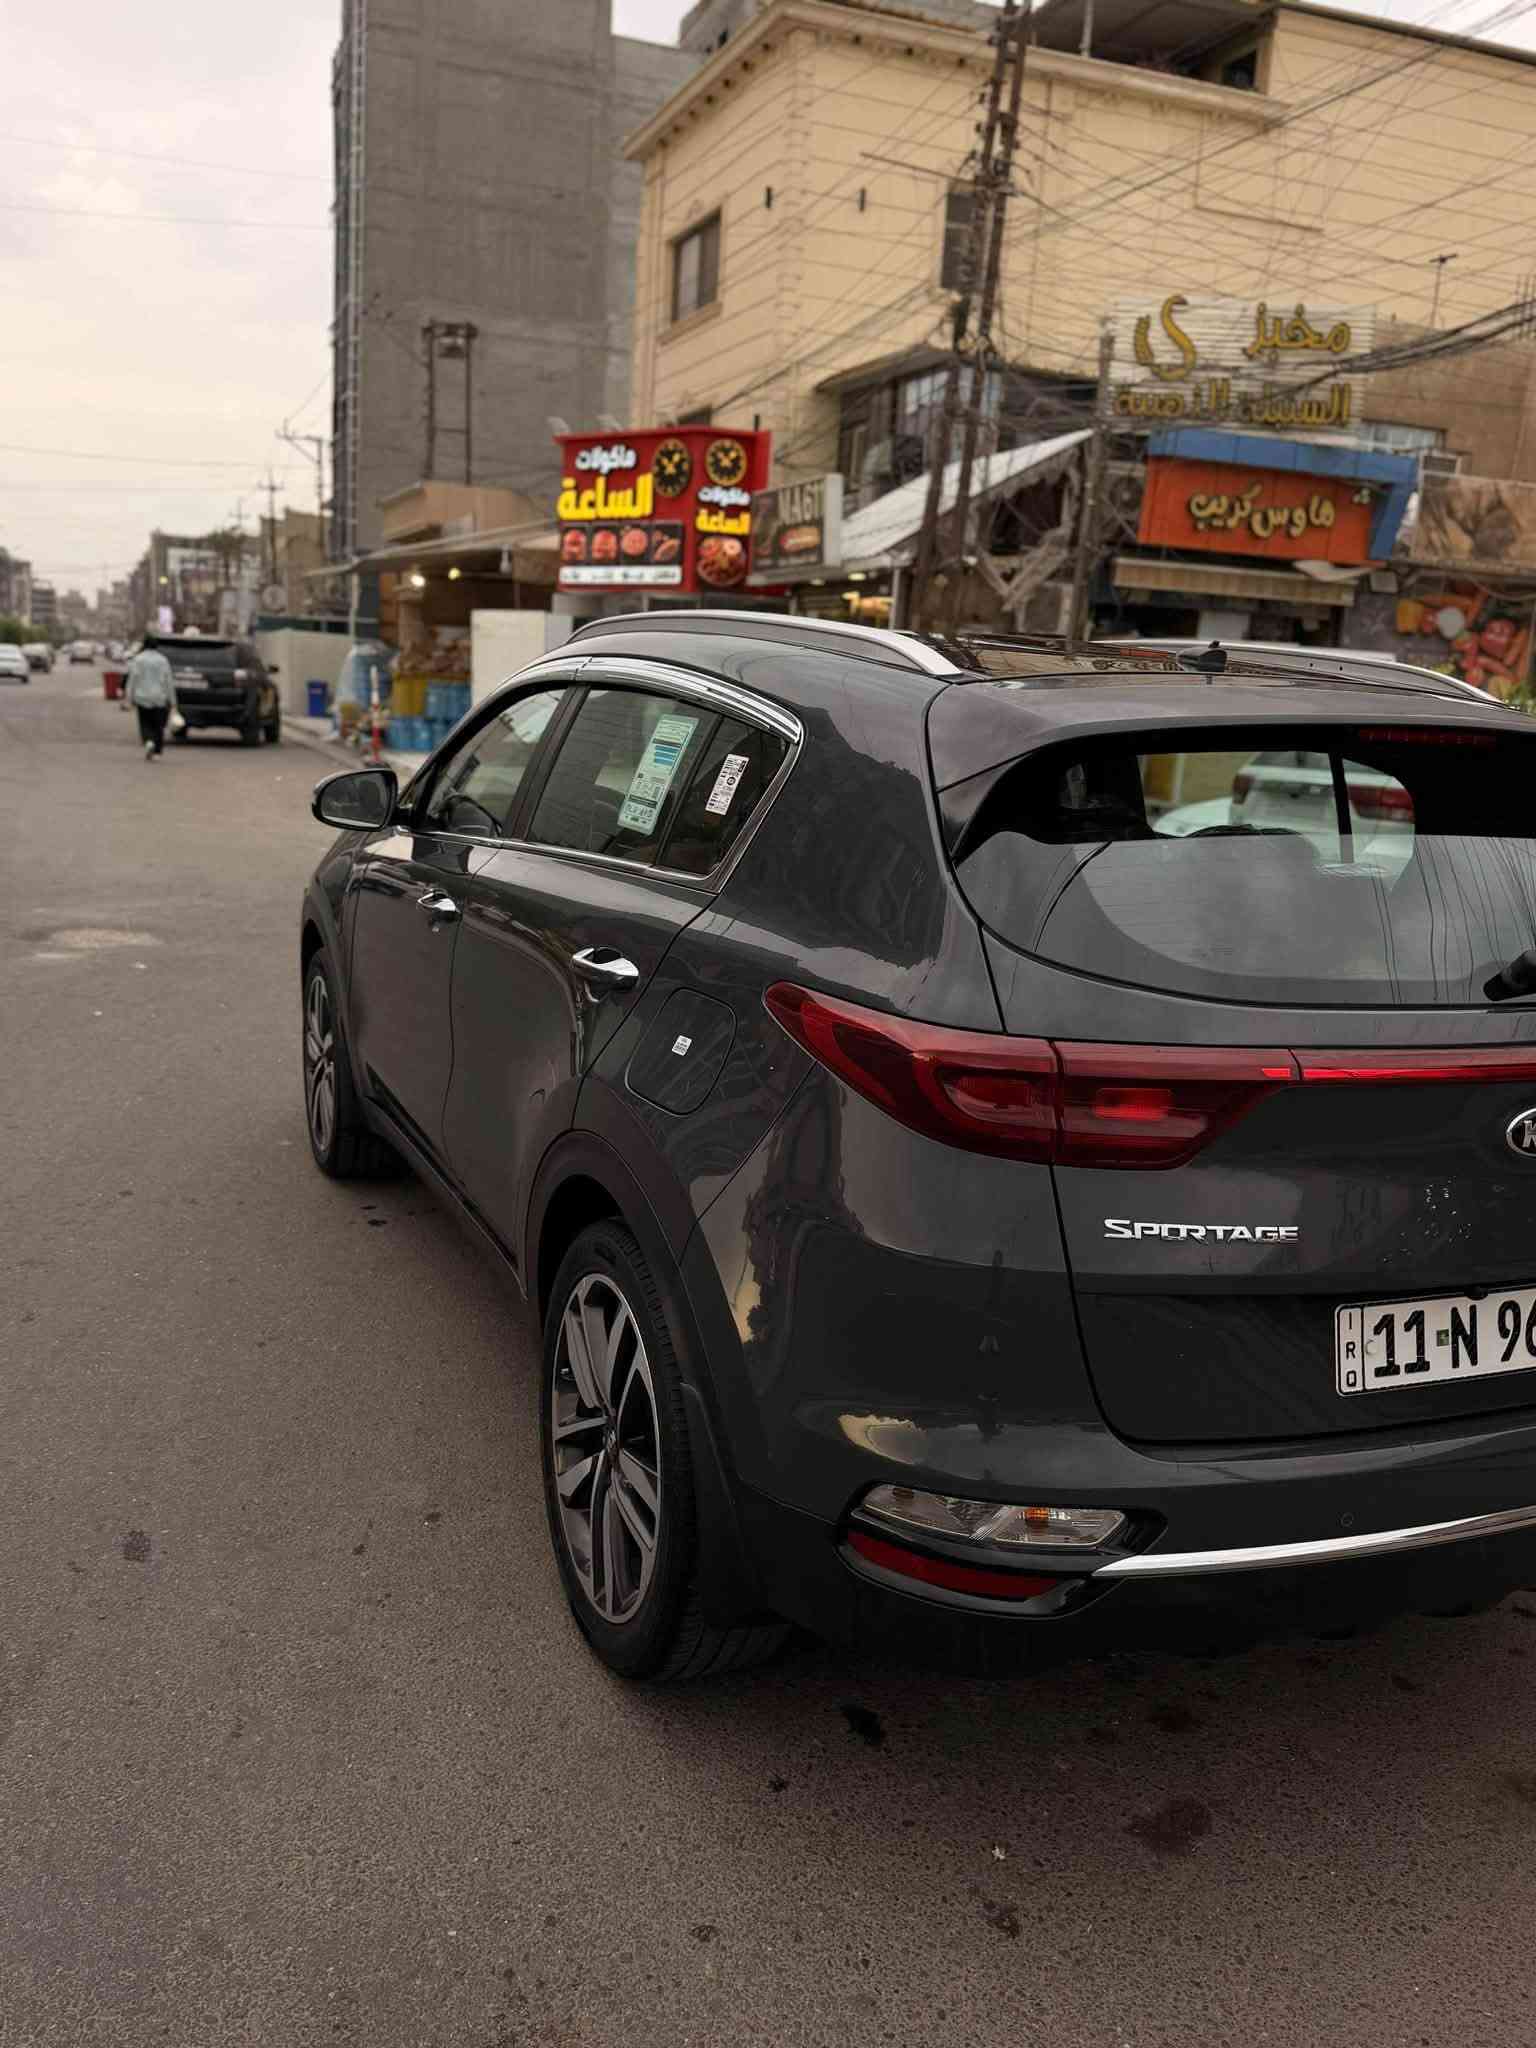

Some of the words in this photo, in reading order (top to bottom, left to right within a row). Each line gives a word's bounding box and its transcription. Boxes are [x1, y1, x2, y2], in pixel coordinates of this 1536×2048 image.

[1241, 301, 1351, 361] مخبز
[557, 472, 653, 520] الساعة
[1190, 484, 1263, 531] كريب
[1251, 496, 1336, 538] هاوس
[696, 508, 751, 536] الساعة
[1103, 1218, 1299, 1245] SPORTAGE
[1345, 1311, 1358, 1388] IRQ
[1373, 1310, 1431, 1378] 11
[1451, 1304, 1478, 1369] N
